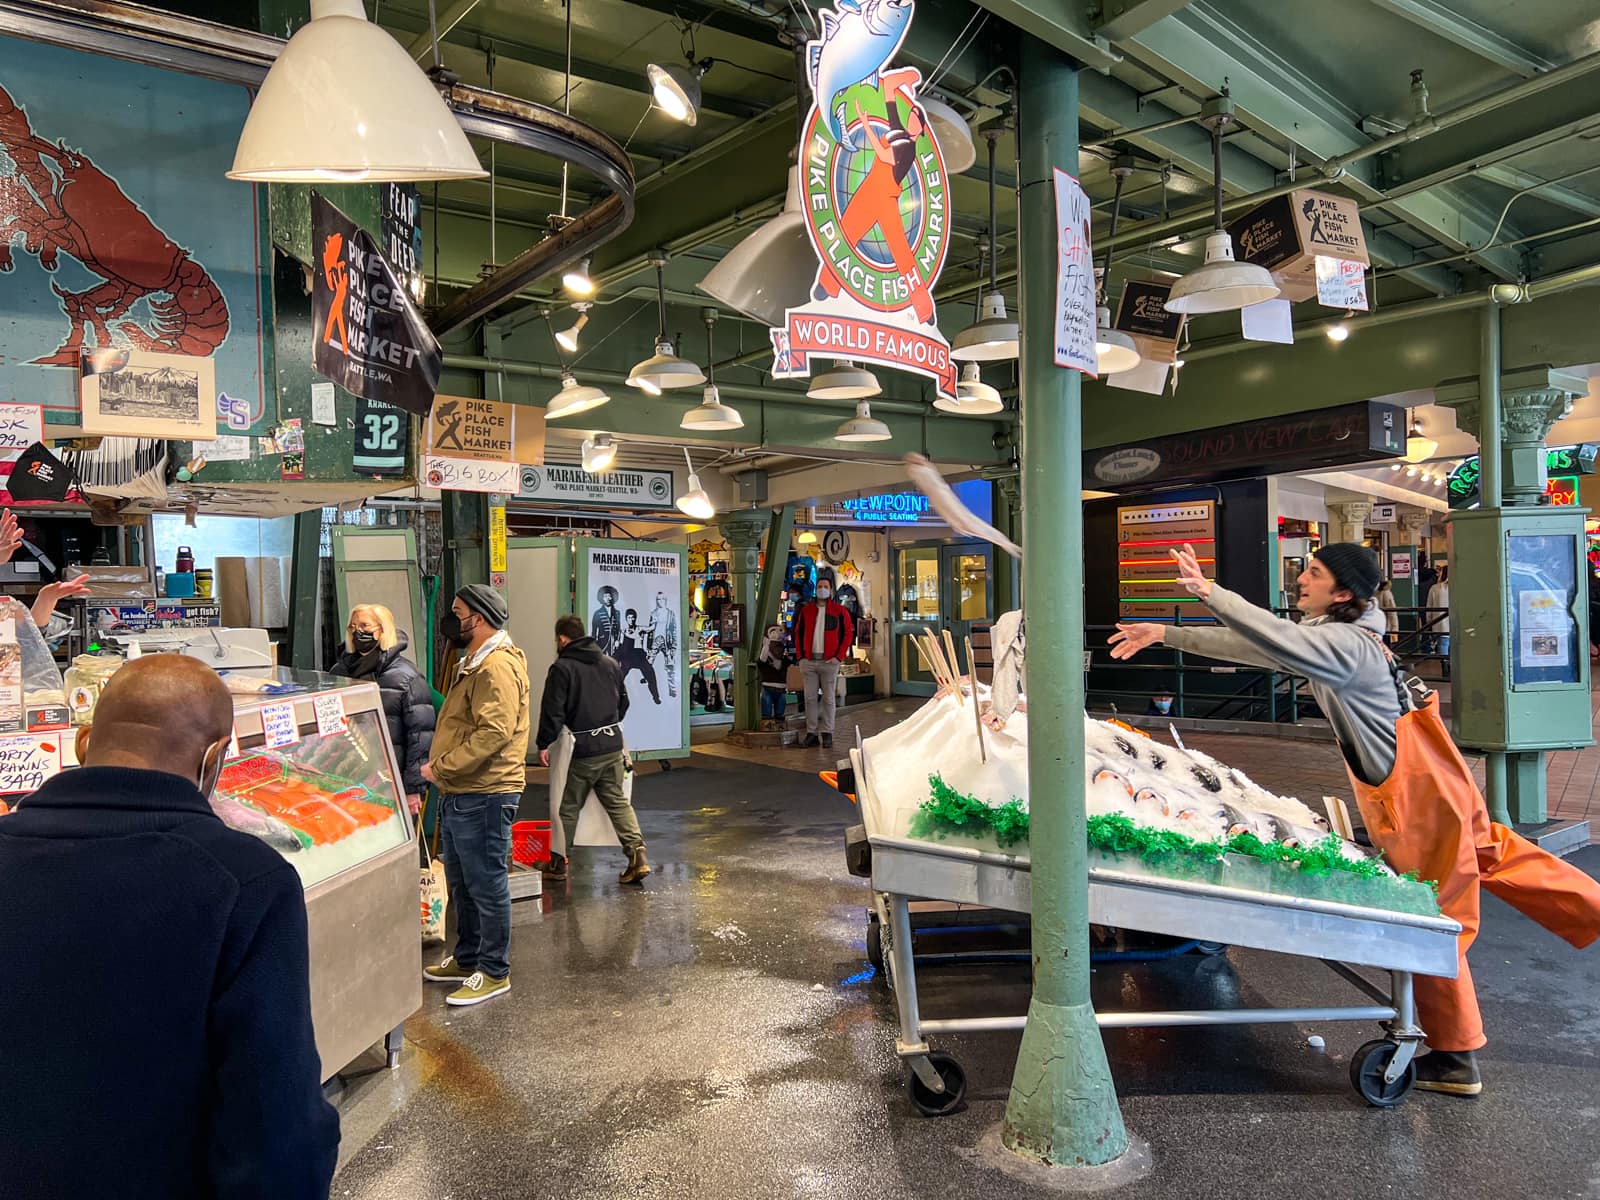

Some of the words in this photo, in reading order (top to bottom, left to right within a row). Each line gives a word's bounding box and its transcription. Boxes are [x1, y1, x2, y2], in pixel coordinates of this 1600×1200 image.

[810, 133, 829, 212] PIKE
[389, 181, 414, 228] FEAR
[919, 152, 944, 273] MARKET
[1319, 199, 1338, 211] PIKE
[1321, 210, 1349, 224] PLACE
[394, 220, 409, 239] THE
[1323, 221, 1343, 233] FISH
[1326, 232, 1359, 246] MARKET
[348, 239, 383, 277] PIKE
[819, 220, 876, 298] PLACE
[881, 267, 921, 301] FISH
[349, 296, 374, 329] FISH
[347, 322, 421, 370] MARKET
[795, 319, 870, 350] WORLD
[875, 330, 947, 371] FAMOUS
[466, 401, 493, 414] PIKE
[465, 413, 505, 427] PLACE
[362, 414, 400, 451] 32
[464, 425, 492, 437] FISH
[463, 437, 512, 451] MARKET
[1160, 435, 1235, 463] SOUND
[1242, 425, 1298, 450] VIEW
[546, 468, 599, 485] MARAKESH
[603, 471, 644, 487] LEATHER
[842, 494, 929, 512] VIEWPOINT
[863, 512, 887, 520] PUBLIC
[889, 513, 918, 521] SEATING
[1124, 512, 1162, 520] MARKET
[1167, 509, 1205, 517] LEVELS
[592, 553, 640, 566] MARAKESH
[641, 556, 676, 568] LEATHER
[599, 565, 623, 573] ROCKING
[623, 566, 644, 574] SEATTLE
[186, 608, 198, 618] got
[199, 607, 219, 616] fish?
